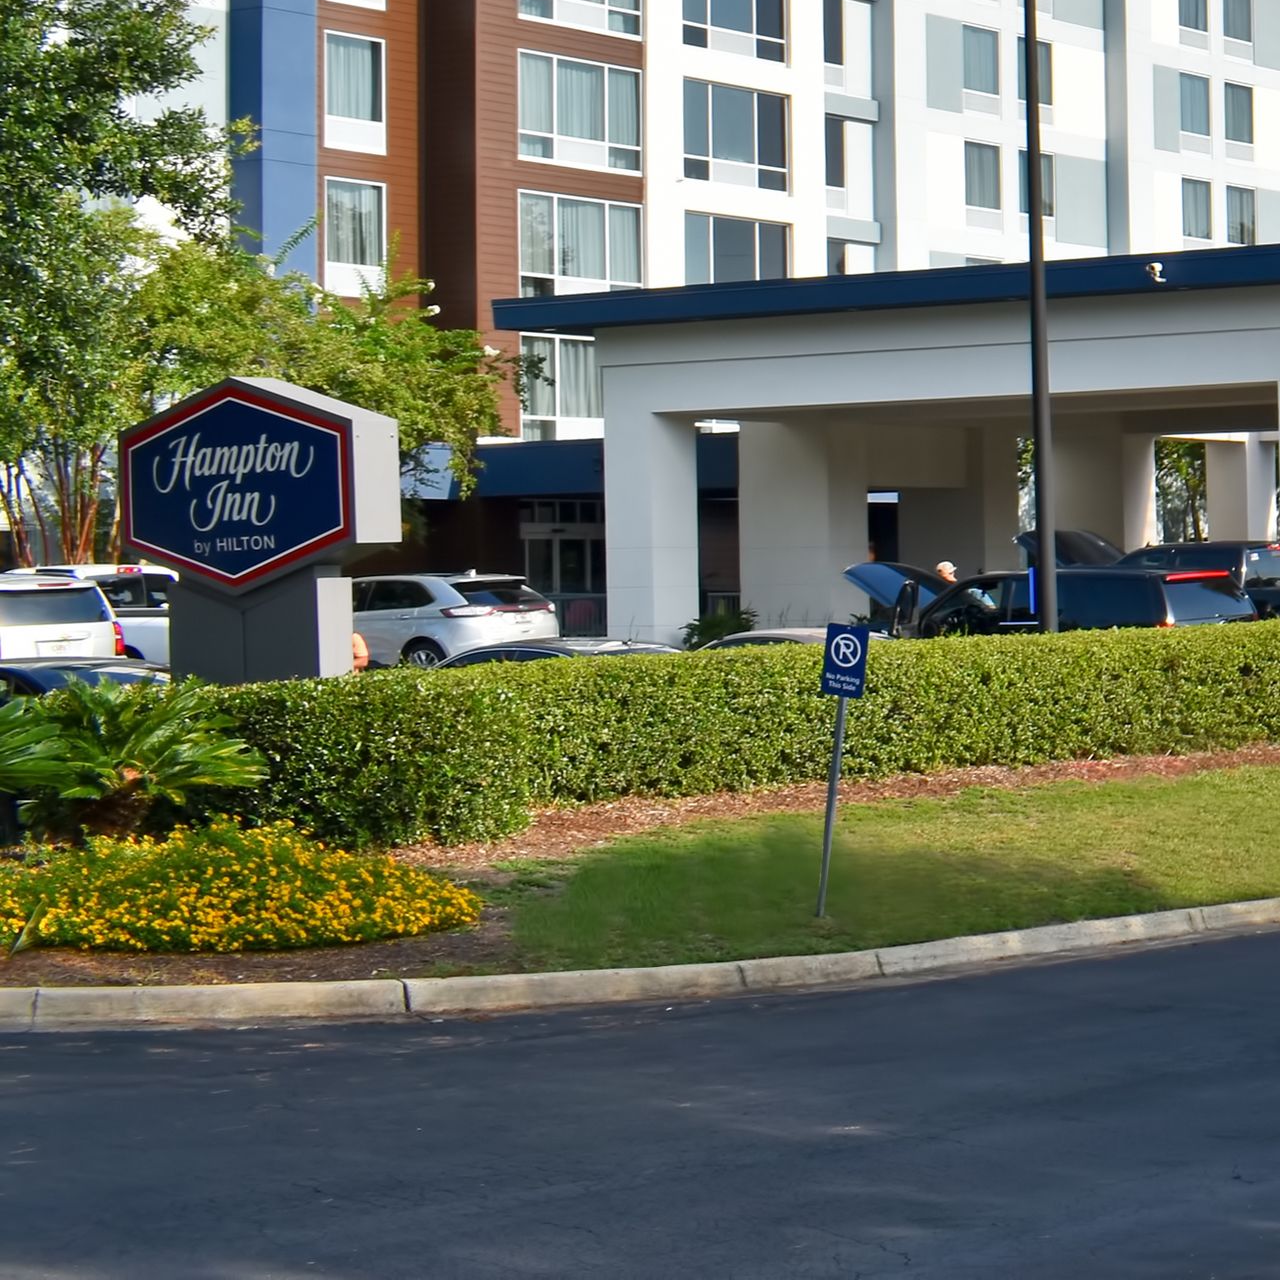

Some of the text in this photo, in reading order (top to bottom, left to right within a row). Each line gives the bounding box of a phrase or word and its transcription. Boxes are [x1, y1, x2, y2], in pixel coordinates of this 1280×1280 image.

[153, 432, 314, 493] Hampton
[190, 480, 275, 532] Inn
[194, 534, 276, 556] by HILTON
[826, 672, 860, 685] No Parking
